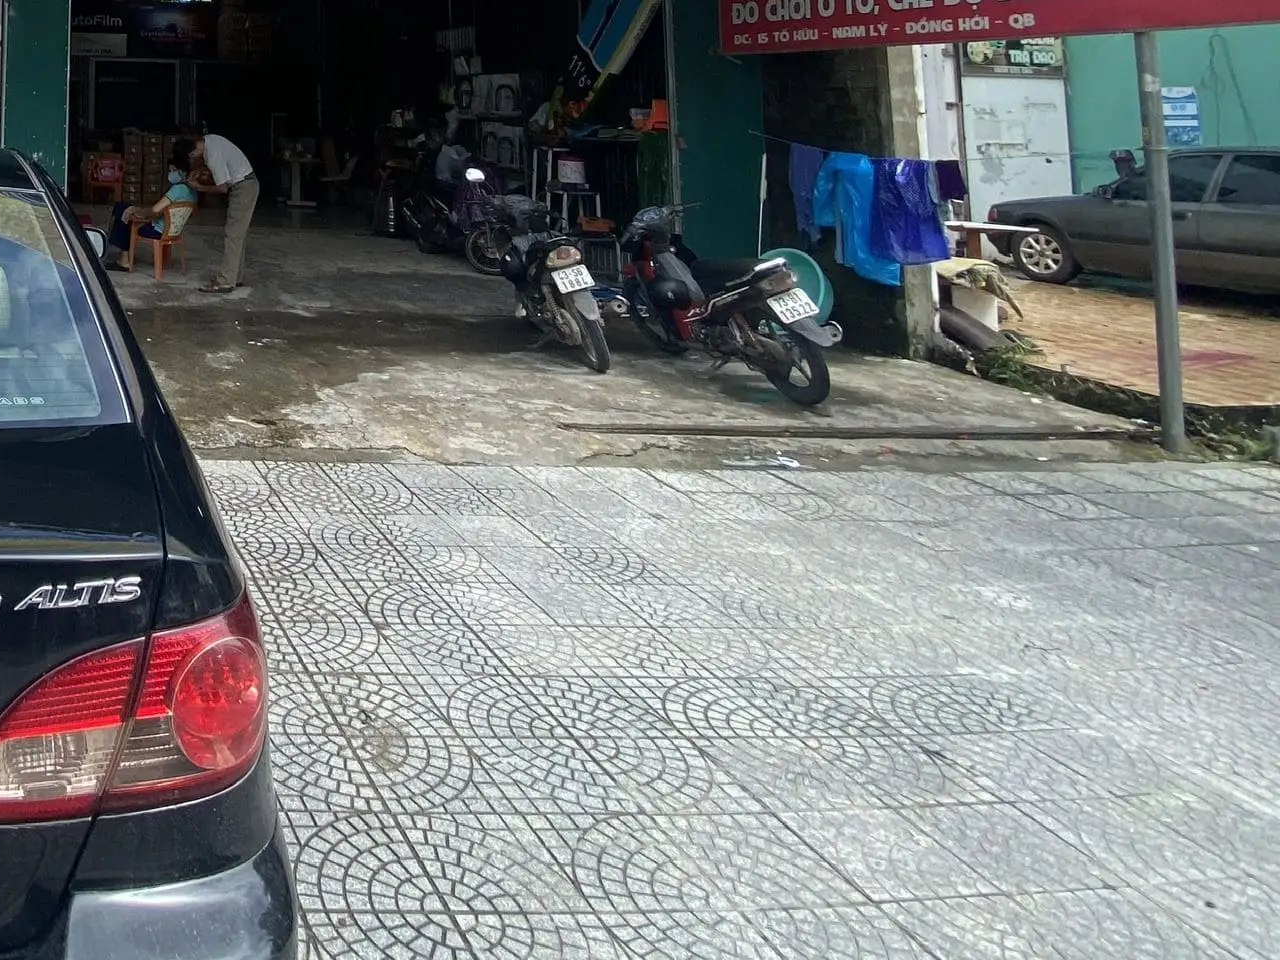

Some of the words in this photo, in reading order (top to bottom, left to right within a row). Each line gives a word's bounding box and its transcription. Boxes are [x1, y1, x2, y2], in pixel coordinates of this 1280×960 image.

[757, 32, 770, 44] 15
[832, 25, 866, 39] NAM
[869, 21, 889, 37] LÝ
[1008, 12, 1036, 30] QB
[13, 576, 142, 611] ALTIS
